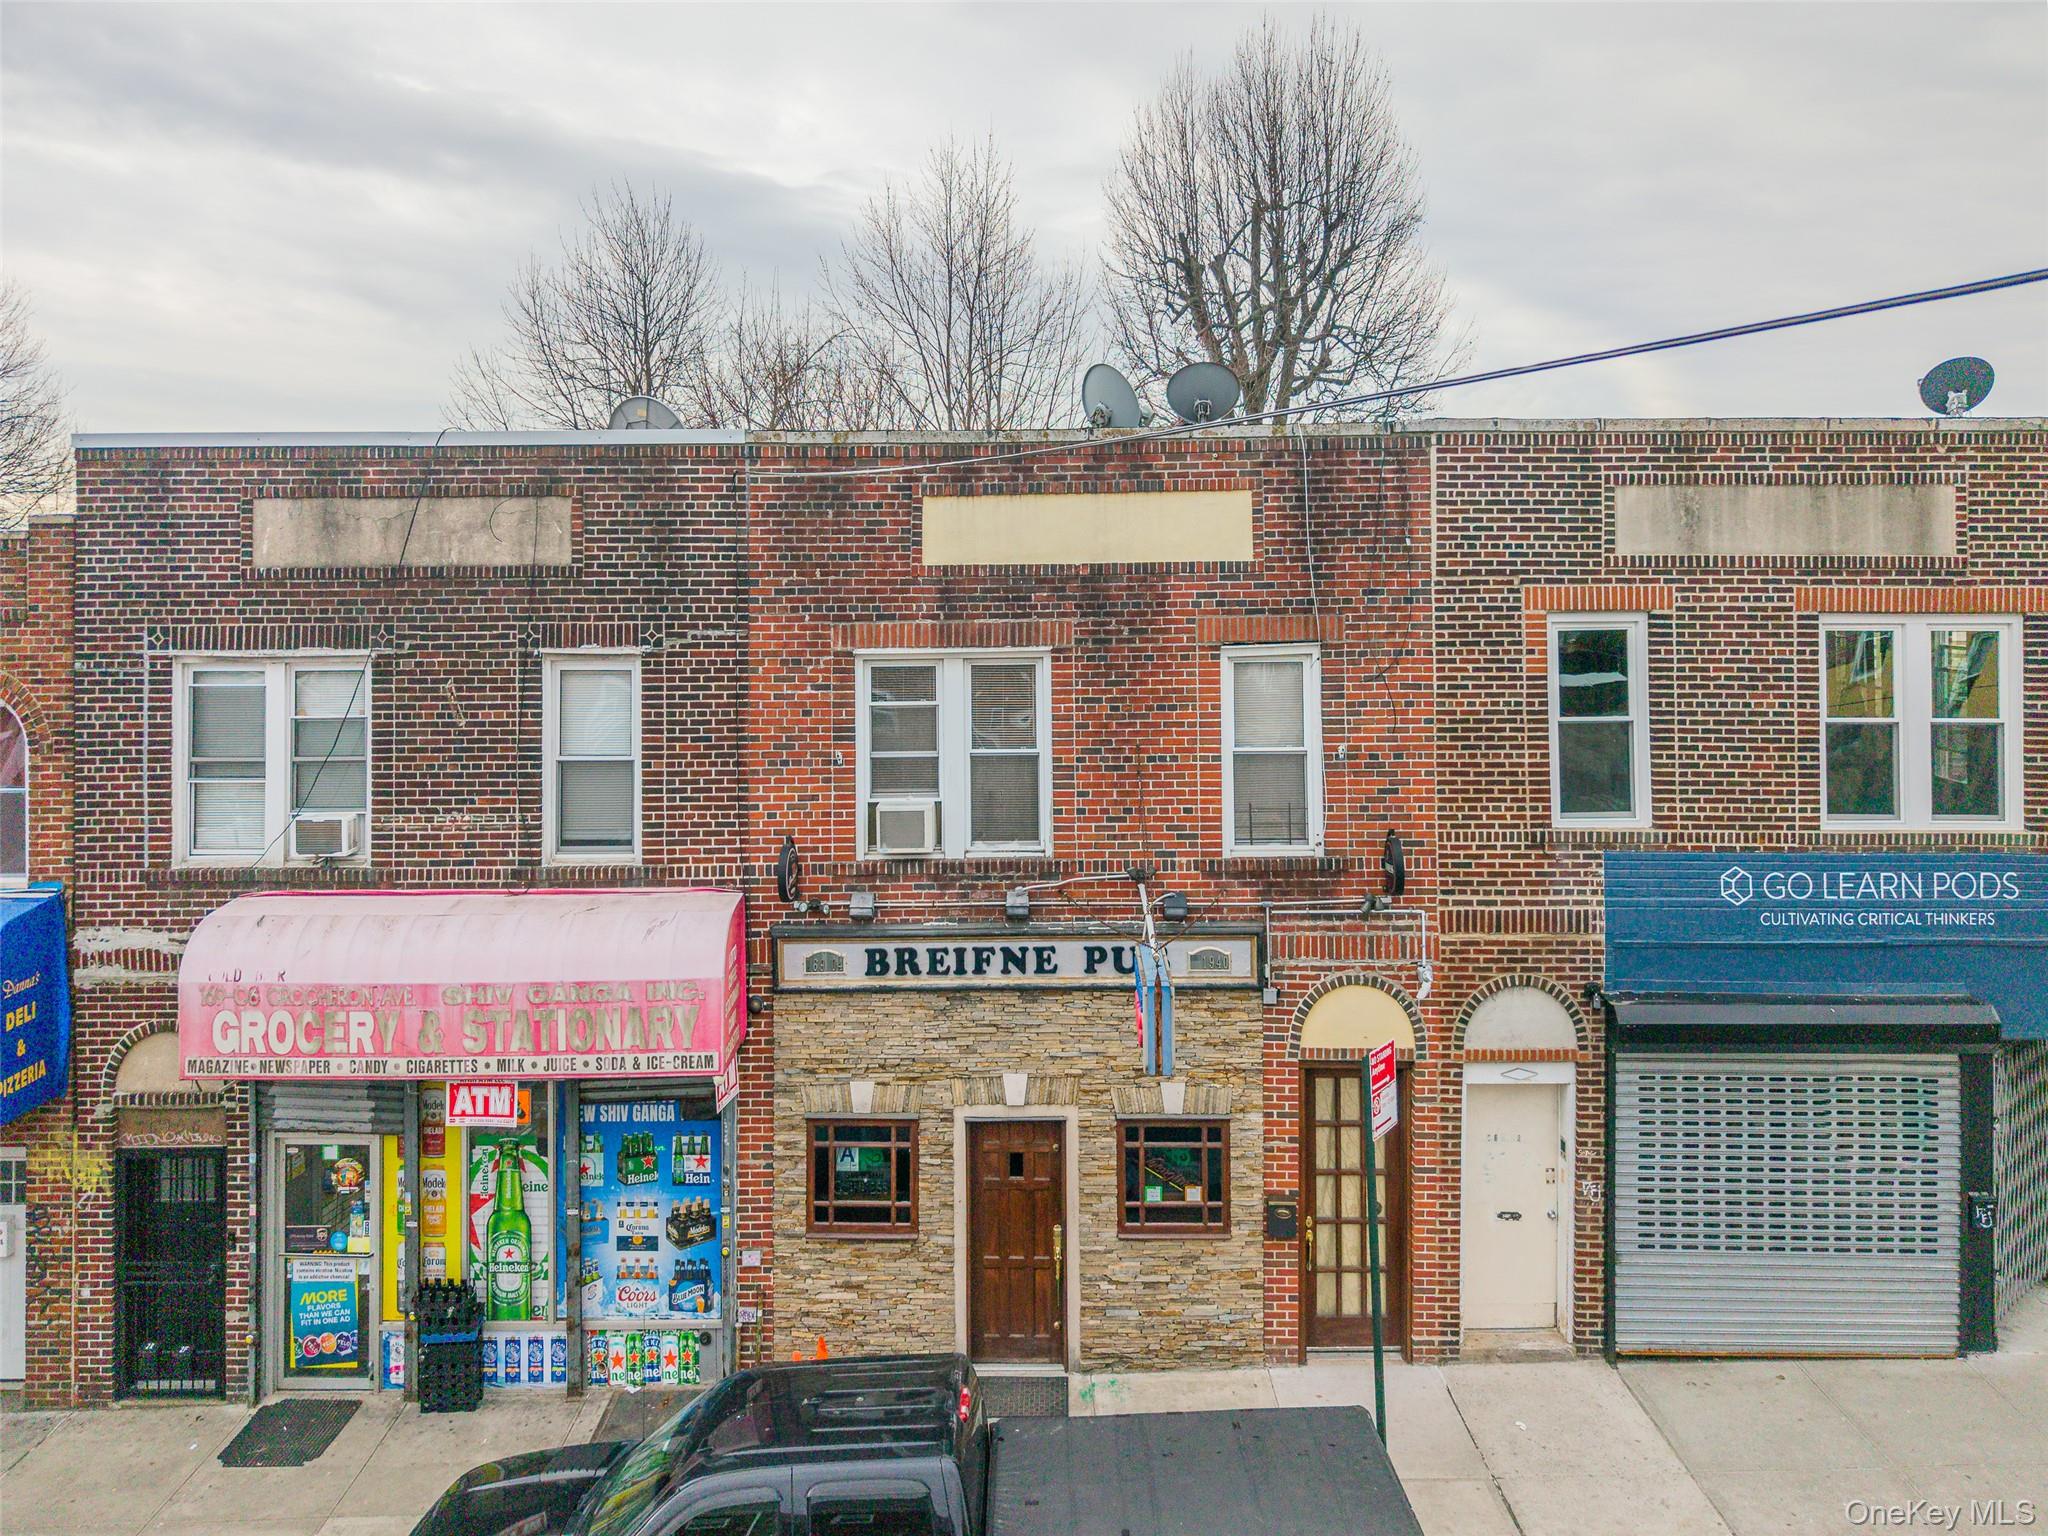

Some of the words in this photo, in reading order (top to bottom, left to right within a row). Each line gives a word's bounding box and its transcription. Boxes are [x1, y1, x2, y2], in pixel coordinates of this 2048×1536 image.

[1763, 871, 1813, 899] GO
[1823, 871, 1922, 899] LEARN
[1933, 871, 2020, 900] PODS
[1760, 912, 1855, 926] CULTIVATING
[1858, 912, 1922, 926] CRITICAL
[1925, 912, 1995, 926] THINKERS
[864, 945, 1058, 976] BREIFNE
[1084, 945, 1170, 975] PU
[527, 982, 634, 1005] GANGA
[6, 1001, 36, 1032] DELI
[211, 1009, 401, 1056] GROCERY
[417, 1010, 445, 1055] &
[461, 1004, 702, 1055] STATIONARY
[16, 1038, 26, 1057] &
[187, 1059, 249, 1075] MAGAZINE
[259, 1059, 330, 1075] NEWSPAPER
[350, 1059, 388, 1075] CANDY
[406, 1057, 478, 1074] CIGARETTES
[497, 1057, 525, 1073] MILK
[543, 1056, 577, 1072] JUICE
[596, 1056, 627, 1072] SODA
[632, 1056, 641, 1071] &
[647, 1054, 714, 1071] ICE-CREAM
[453, 1086, 511, 1115] ATM
[600, 1103, 629, 1122] SHIV
[632, 1103, 675, 1122] GANGA
[840, 1147, 855, 1163] A
[685, 1173, 710, 1184] Hein
[626, 1223, 649, 1232] Corona
[489, 1262, 530, 1273] Heineken
[300, 1289, 348, 1305] MORE
[618, 1285, 657, 1302] Coors
[687, 1286, 704, 1298] MOON
[299, 1311, 320, 1320] THAN
[321, 1310, 333, 1318] WE
[334, 1308, 350, 1316] CAN
[307, 1302, 341, 1311] FLAVORS
[313, 1318, 321, 1326] IN
[322, 1316, 338, 1325] ONE
[340, 1315, 351, 1323] AD
